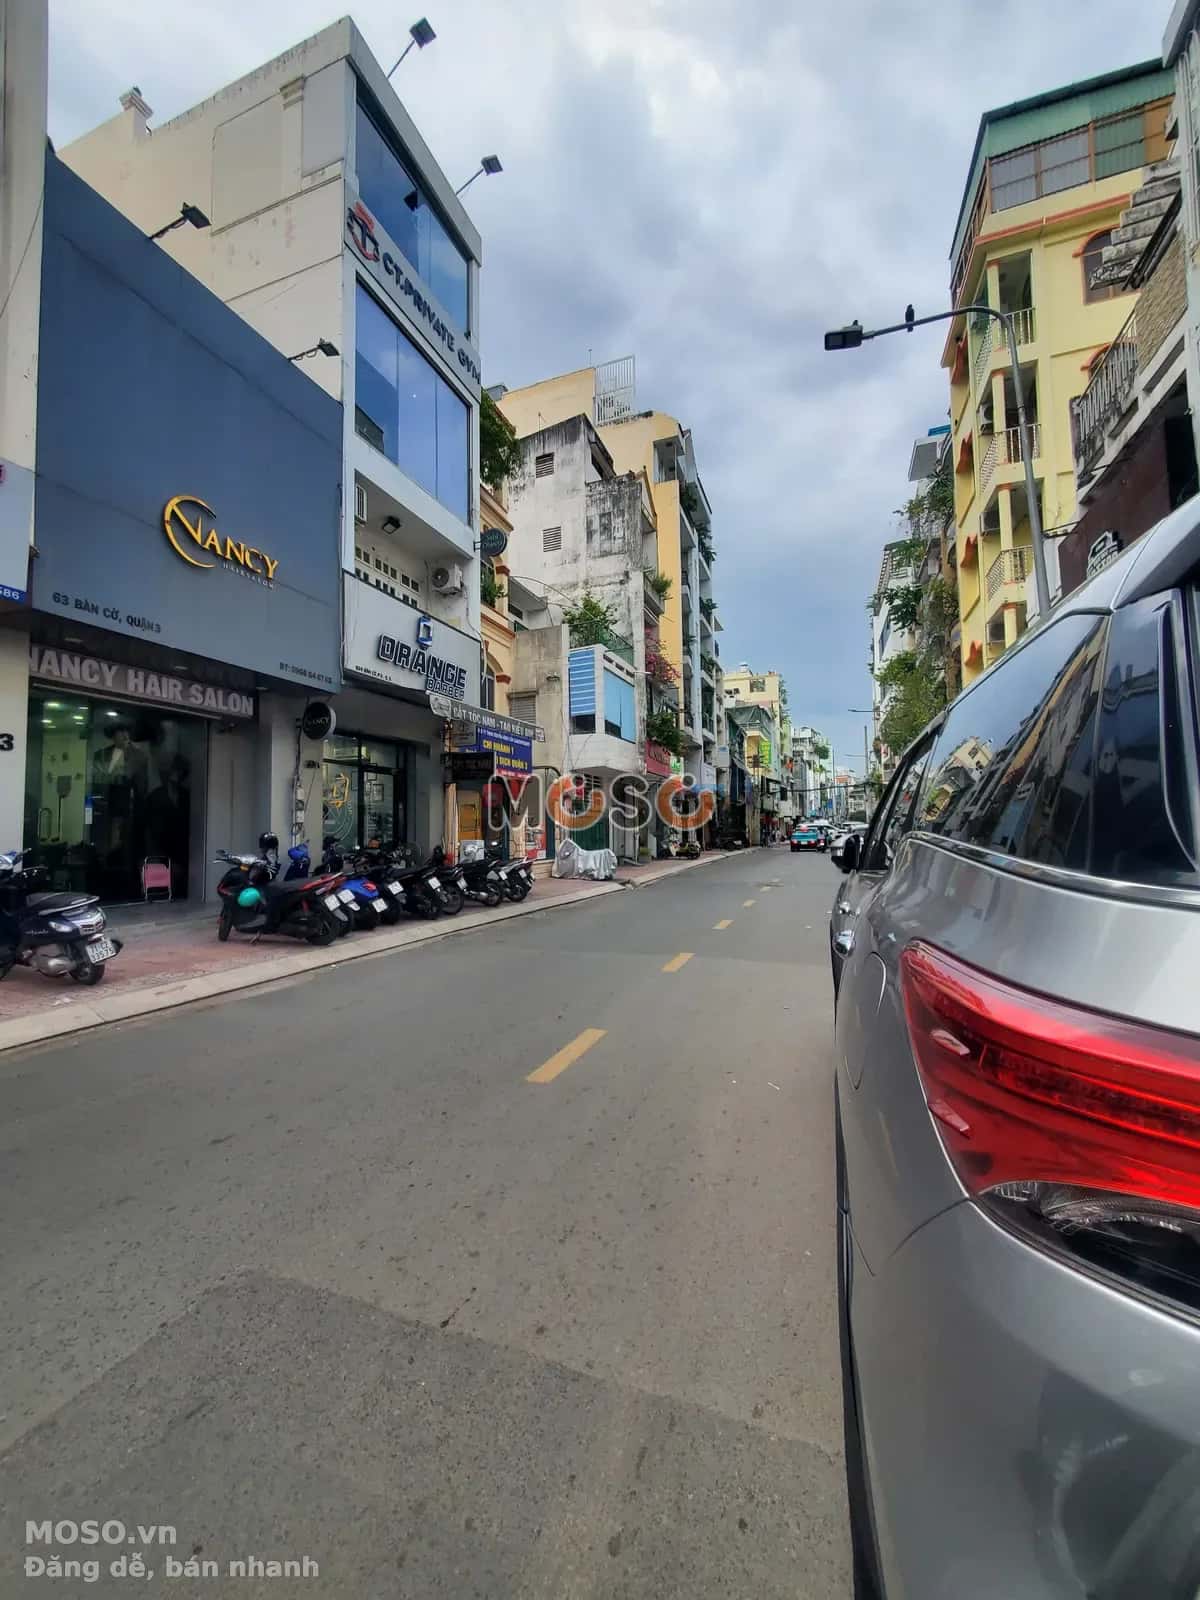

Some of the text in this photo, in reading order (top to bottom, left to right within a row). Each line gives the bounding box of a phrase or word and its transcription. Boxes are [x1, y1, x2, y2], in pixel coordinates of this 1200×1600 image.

[164, 494, 279, 579] NANCY
[52, 592, 69, 606] 63
[74, 598, 99, 615] BÀN
[29, 648, 254, 717] NANCY HAIR SALON
[376, 633, 467, 688] ORANGE
[426, 677, 465, 701] BARBER
